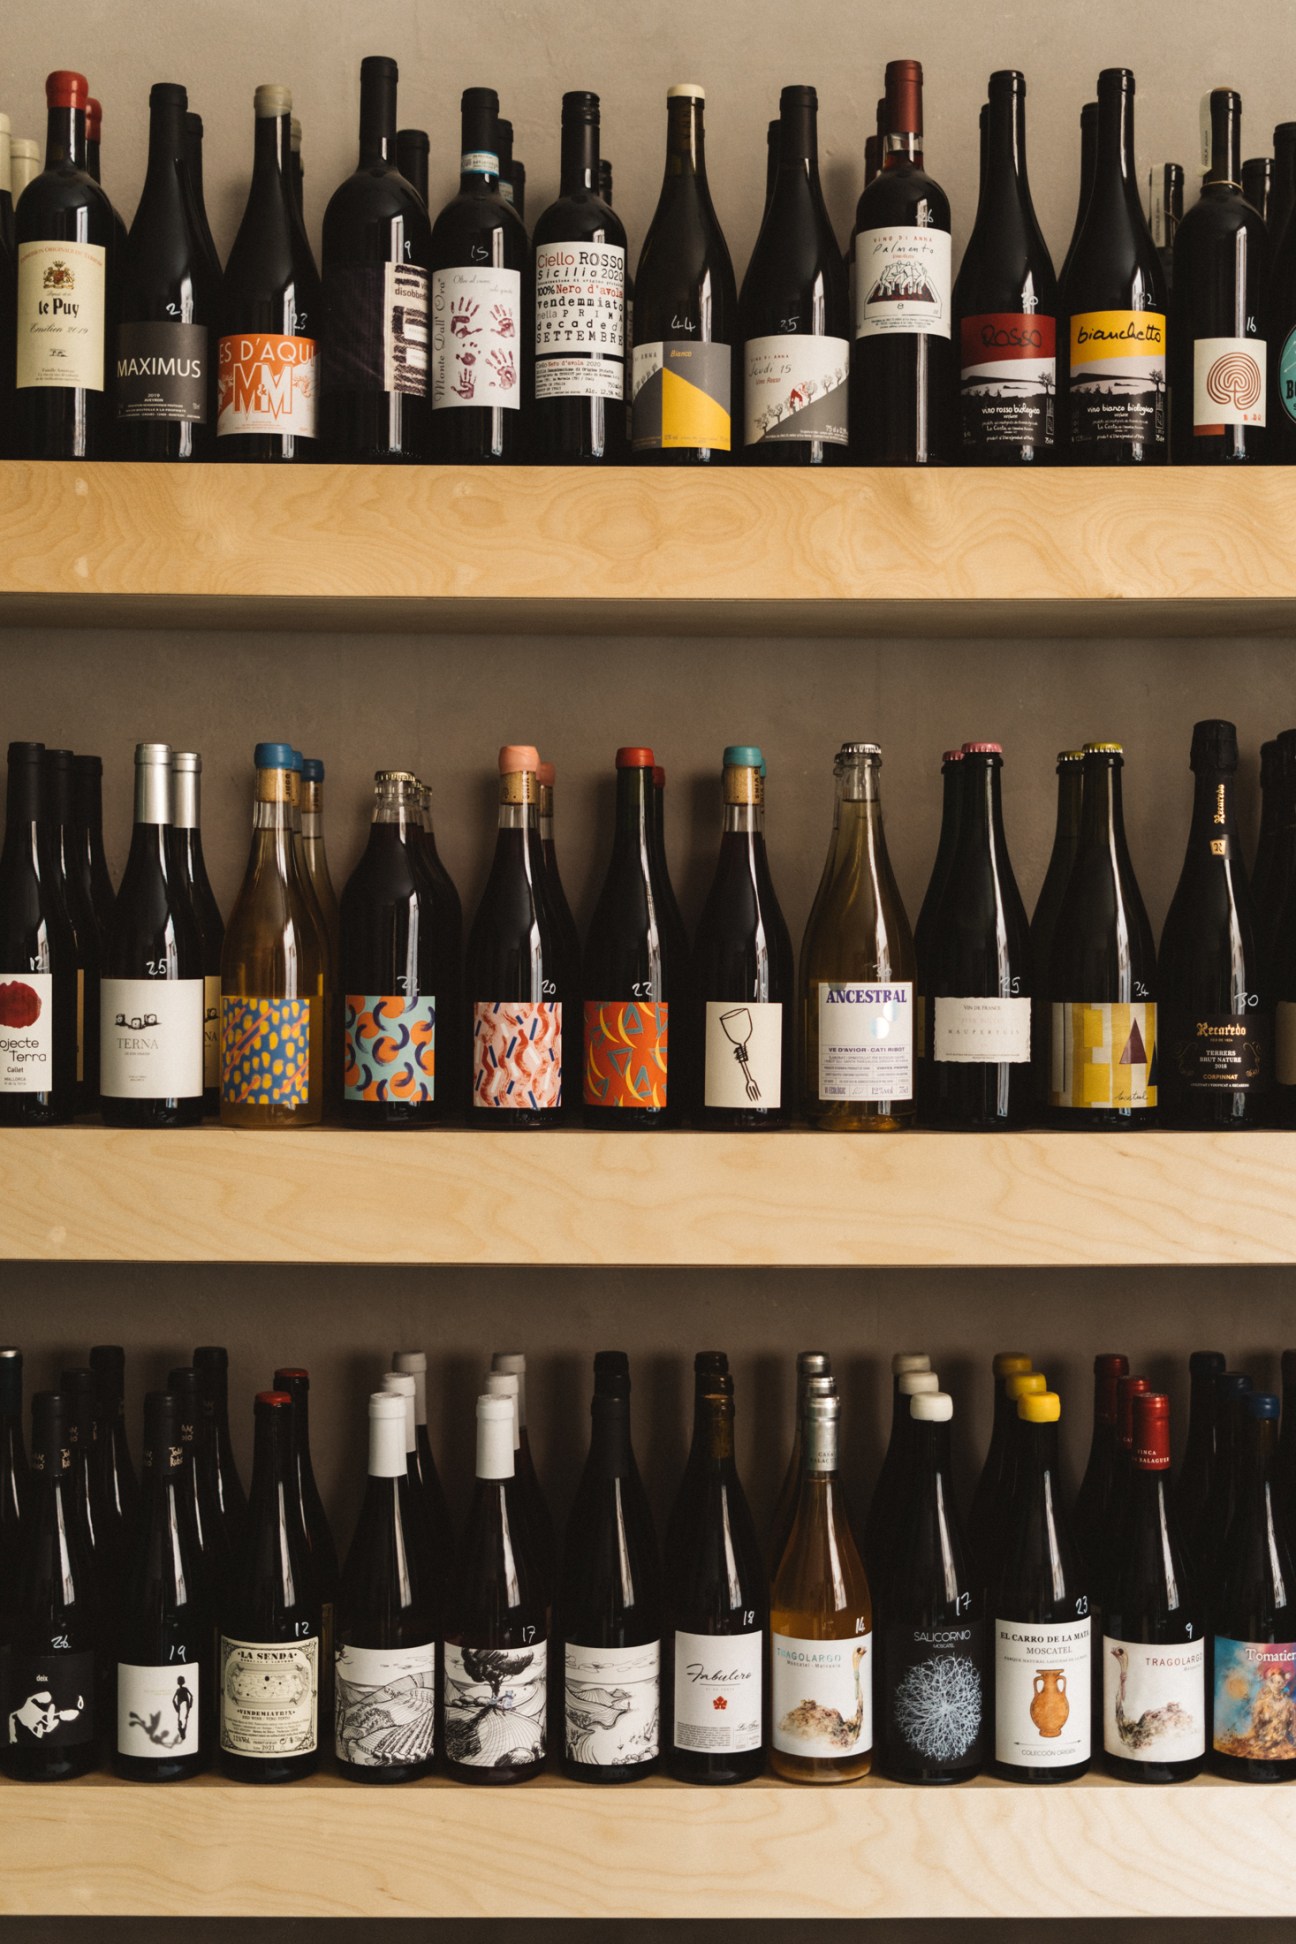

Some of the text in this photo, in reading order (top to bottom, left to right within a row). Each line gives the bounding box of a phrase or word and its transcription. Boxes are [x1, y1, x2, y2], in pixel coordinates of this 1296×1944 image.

[873, 235, 893, 243] VINO
[404, 240, 411, 259] 9
[470, 245, 489, 261] 15
[873, 241, 934, 255] Palmento
[537, 252, 623, 270] Ciello ROSSO
[537, 268, 624, 282] Sicilia 2020
[537, 284, 623, 299] 100% Nero d'avola
[53, 298, 79, 318] Puy
[537, 296, 623, 312] vendemmiato
[537, 310, 557, 321] nella
[671, 315, 696, 332] 44
[537, 319, 606, 331] decade
[780, 316, 800, 332] 25
[1246, 316, 1257, 333] 16
[536, 331, 623, 346] SETTEMBRE
[1077, 321, 1162, 344] bianchetto
[117, 357, 201, 379] MAXIMUS
[780, 364, 792, 374] 15
[435, 355, 445, 402] Monte
[1286, 380, 1296, 399] B
[981, 402, 1040, 418] vino rosso biologico
[1102, 402, 1125, 412] bianco
[1127, 402, 1154, 416] biologico
[146, 958, 168, 975] 25
[541, 979, 556, 994] 20
[632, 982, 654, 996] 22
[1000, 976, 1021, 994] 25
[826, 989, 907, 1004] ANCESTRAL
[1234, 992, 1259, 1008] 30
[1196, 1022, 1247, 1037] Recaredo
[116, 1038, 159, 1050] TERNA
[9, 1050, 47, 1062] Terra
[956, 1592, 972, 1616] 17
[1076, 1595, 1088, 1615] 23
[295, 1622, 310, 1637] 12
[522, 1626, 536, 1643] 17
[914, 1629, 971, 1643] SALICORNIO
[1000, 1632, 1010, 1640] EL
[1012, 1634, 1044, 1643] CARRO
[1047, 1635, 1059, 1643] DE
[1061, 1633, 1072, 1642] LA
[1185, 1622, 1193, 1639] 9
[169, 1645, 186, 1662] 19
[1026, 1646, 1072, 1655] MOSCATEL
